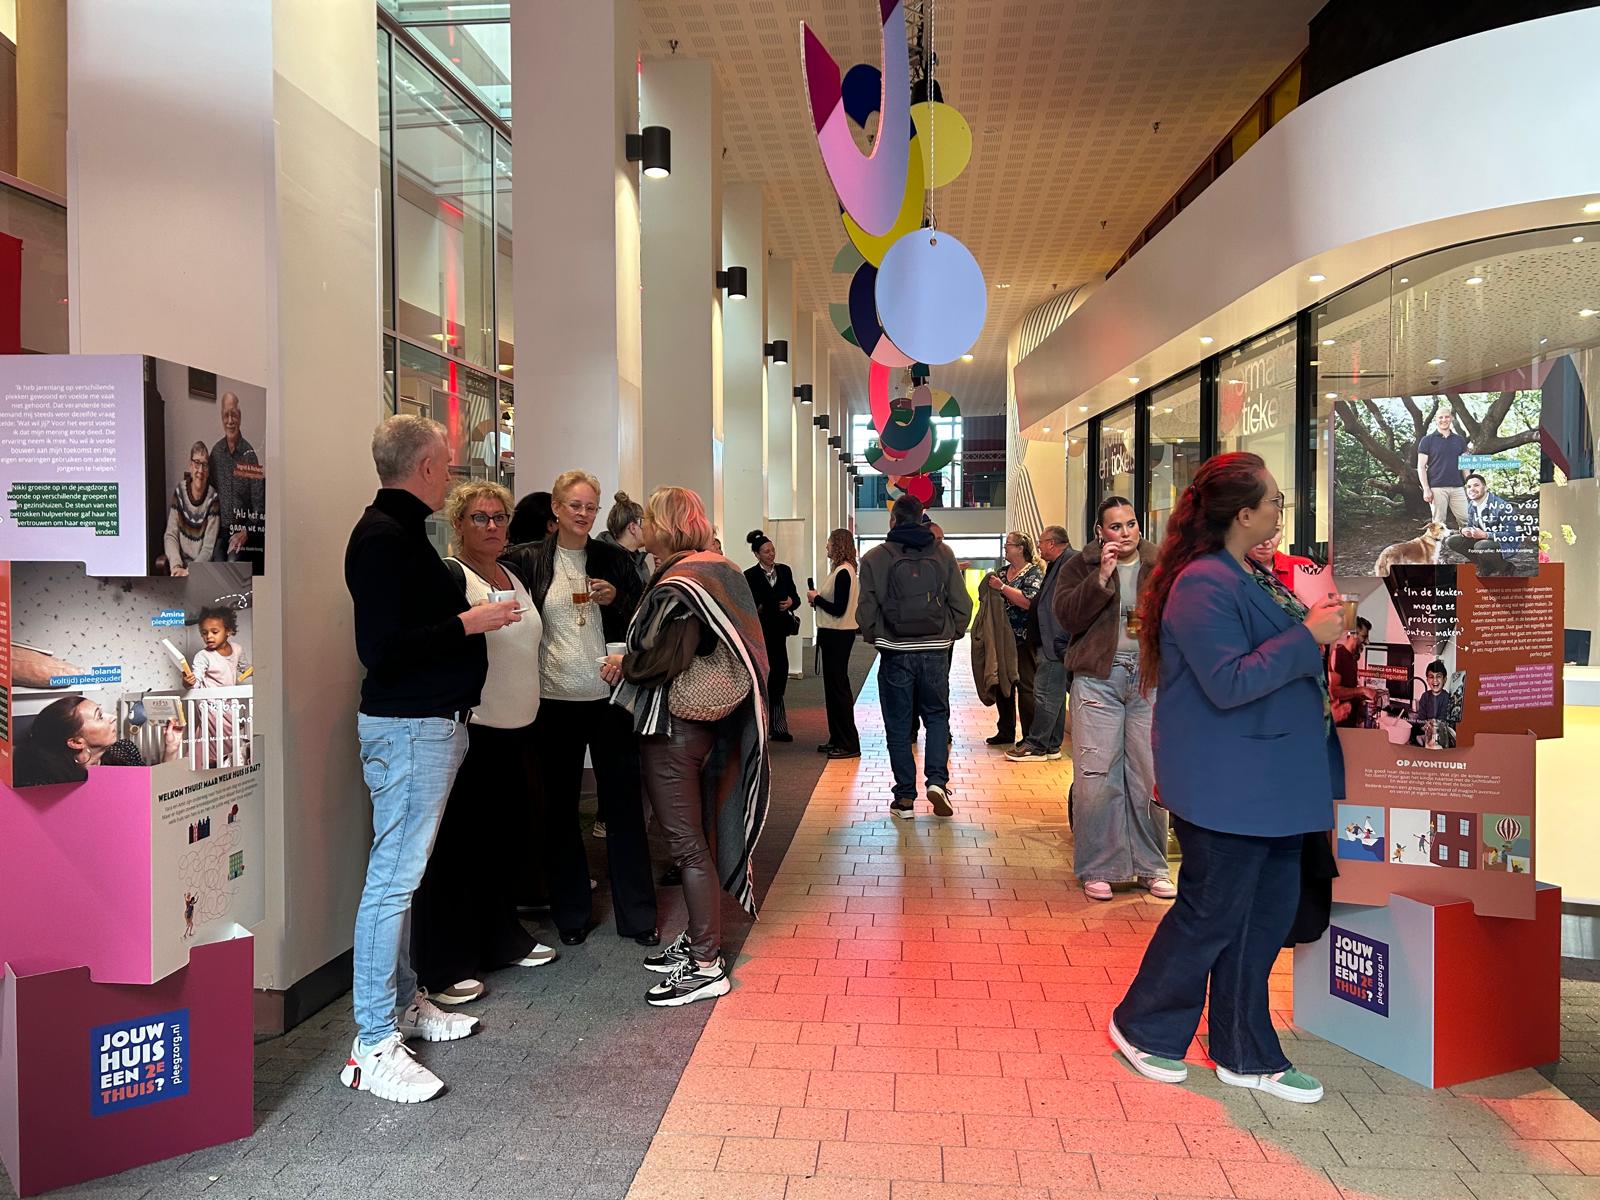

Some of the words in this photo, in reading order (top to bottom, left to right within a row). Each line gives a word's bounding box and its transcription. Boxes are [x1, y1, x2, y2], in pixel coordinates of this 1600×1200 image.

[1242, 393, 1279, 435] ticke
[1489, 501, 1513, 513] Nog
[1474, 513, 1494, 522] het
[1500, 515, 1538, 525] vroeg,
[1484, 523, 1508, 532] het:
[1494, 534, 1526, 542] hoort
[1421, 588, 1432, 597] de
[1436, 588, 1464, 597] keuken
[1408, 614, 1447, 626] proberen
[1413, 604, 1443, 614] mogen
[50, 676, 78, 685] (voltijd)
[80, 675, 121, 684] pleegouder
[91, 668, 120, 676] Jolanda
[1412, 760, 1467, 770] AVONTUUR!
[158, 788, 184, 802] WELKOM
[204, 777, 218, 788] MAAR
[219, 773, 232, 782] WELK
[232, 768, 244, 778] HUIS
[250, 763, 260, 774] DAT?
[1336, 935, 1373, 959] JOUW
[1336, 949, 1373, 976] HUIS
[1336, 965, 1358, 984] EEN
[1361, 976, 1373, 988] 2E
[1336, 978, 1373, 1002] THUIS?
[101, 1022, 164, 1052] JOUW
[101, 1040, 164, 1073] HUIS
[171, 1024, 182, 1084] pleegzorg.nl
[101, 1068, 139, 1089] EEN
[145, 1062, 165, 1079] 2E
[101, 1078, 164, 1104] THUIS?
